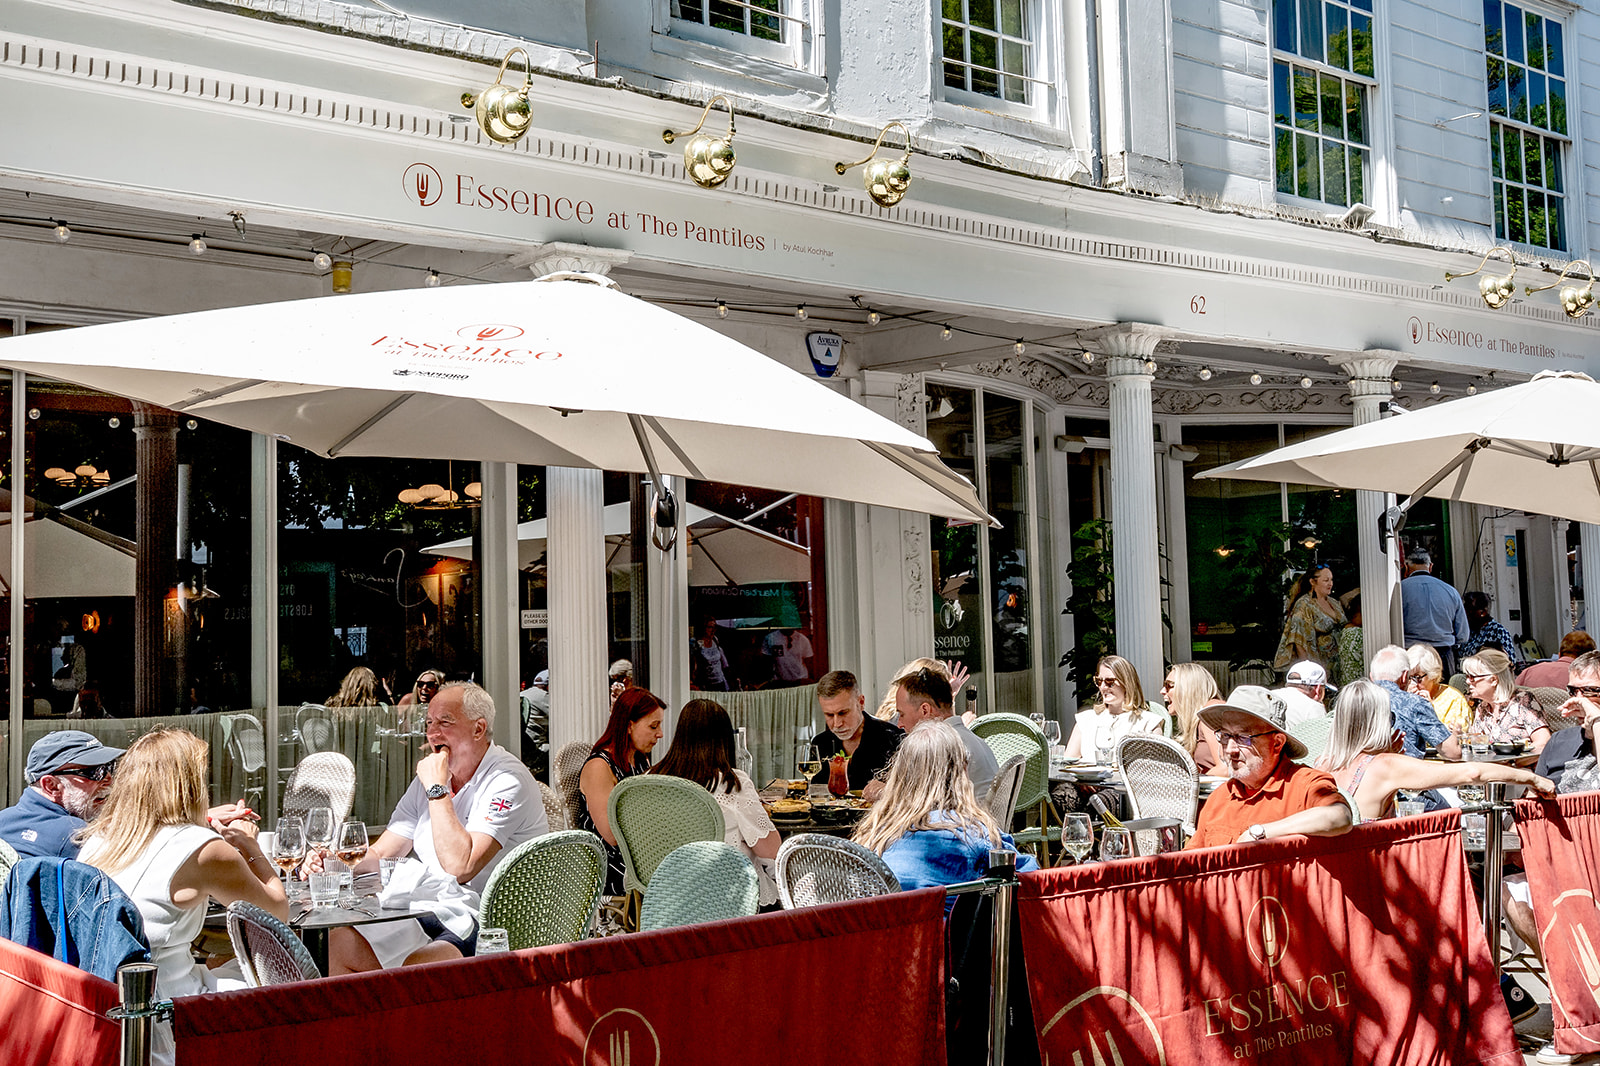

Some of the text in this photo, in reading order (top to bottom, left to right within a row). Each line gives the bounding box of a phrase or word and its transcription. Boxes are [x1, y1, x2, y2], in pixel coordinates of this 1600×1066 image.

[455, 173, 594, 225] Essence
[607, 211, 630, 230] at
[636, 212, 678, 238] The
[684, 220, 766, 251] Pantiles
[782, 243, 791, 252] by
[1190, 294, 1206, 314] 62
[1427, 321, 1483, 348] Essence
[1487, 339, 1497, 351] at
[1500, 338, 1518, 354] The
[1519, 342, 1556, 359] Pantiles
[934, 635, 971, 649] ssence
[1202, 970, 1350, 1037] ESSENCE
[1233, 1023, 1334, 1059] at The Pantiles
